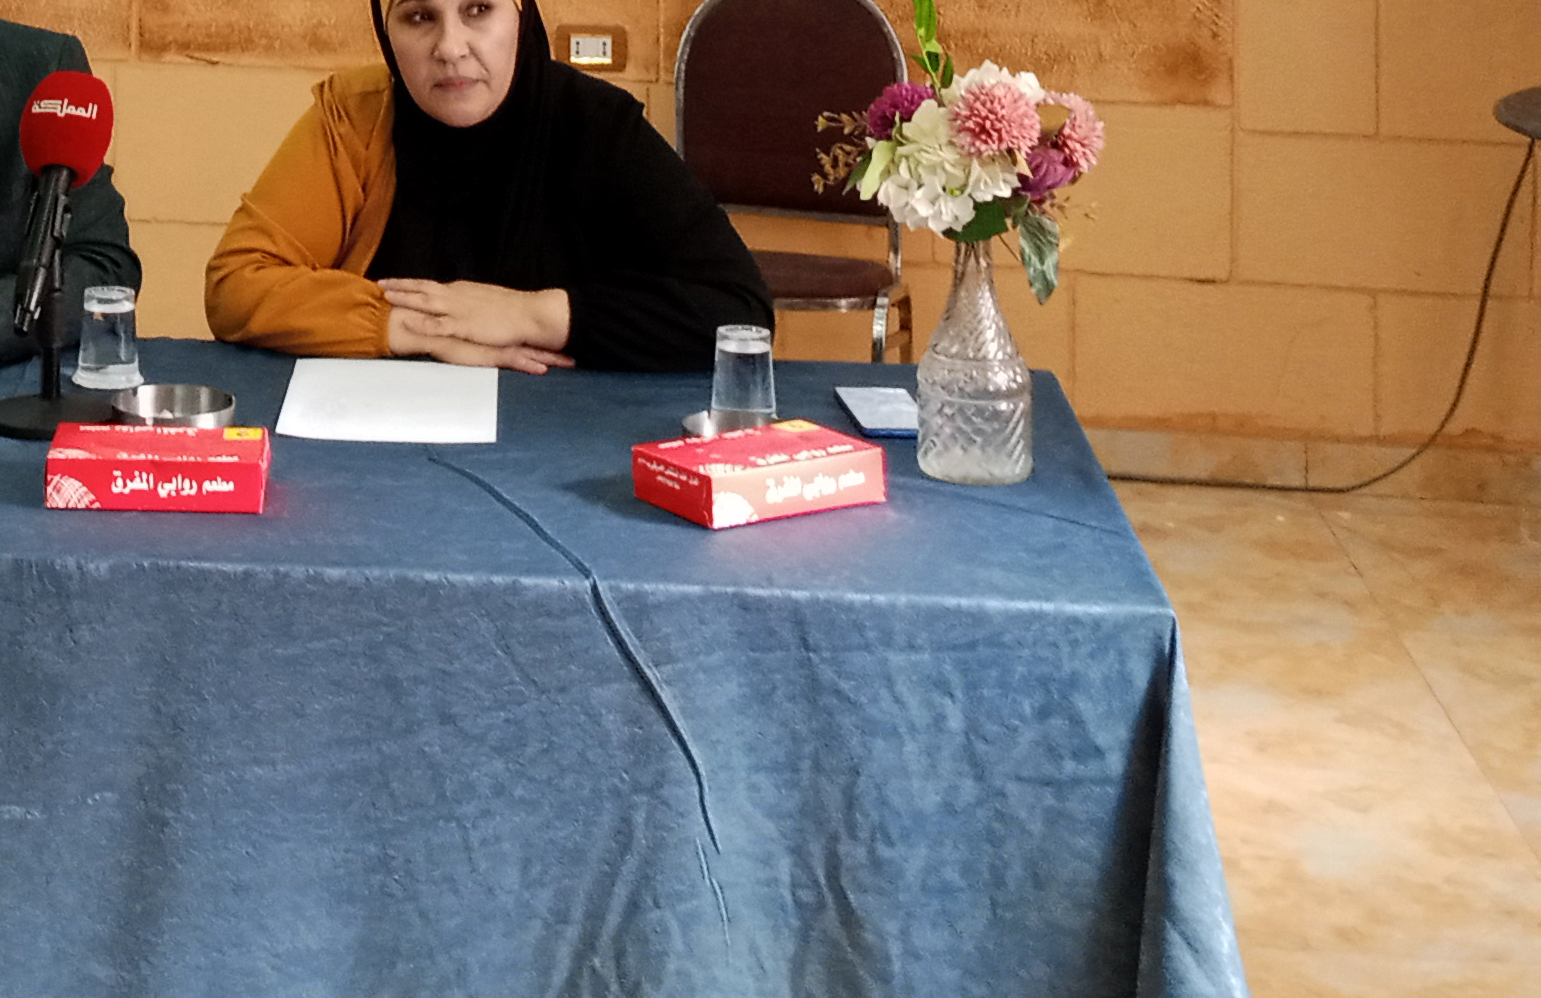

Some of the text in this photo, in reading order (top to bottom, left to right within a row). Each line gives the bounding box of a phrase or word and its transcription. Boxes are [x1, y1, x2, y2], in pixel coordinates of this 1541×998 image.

[31, 98, 98, 120] المملكة
[111, 470, 235, 497] مطعم روابي المفرق
